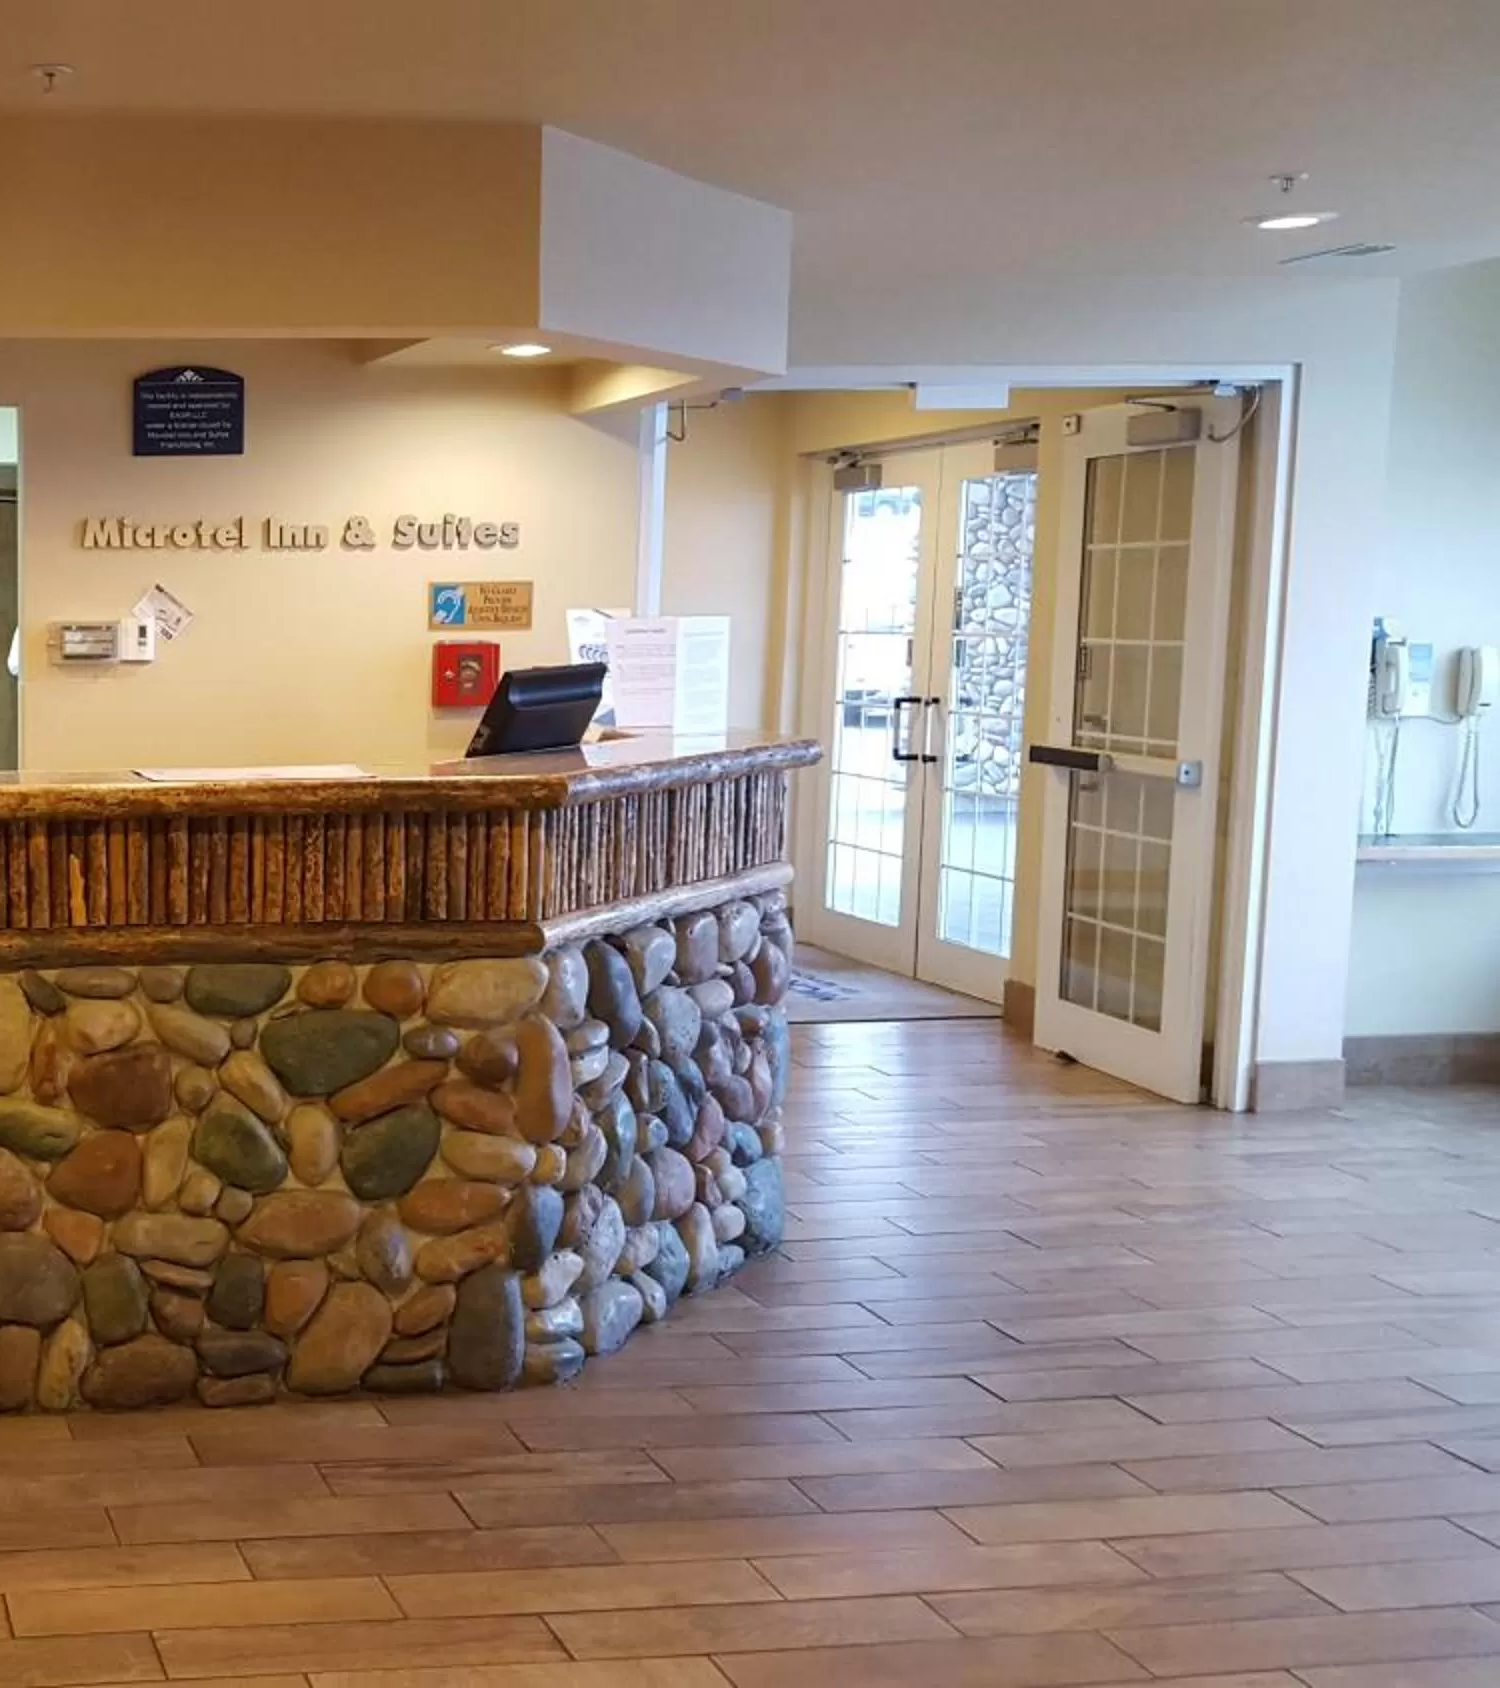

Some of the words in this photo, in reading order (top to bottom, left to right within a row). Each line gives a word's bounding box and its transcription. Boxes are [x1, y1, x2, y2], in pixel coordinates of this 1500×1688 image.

[80, 516, 248, 549] Microtel
[264, 517, 328, 549] Inn
[341, 515, 376, 550] &
[392, 513, 520, 550] Suites
